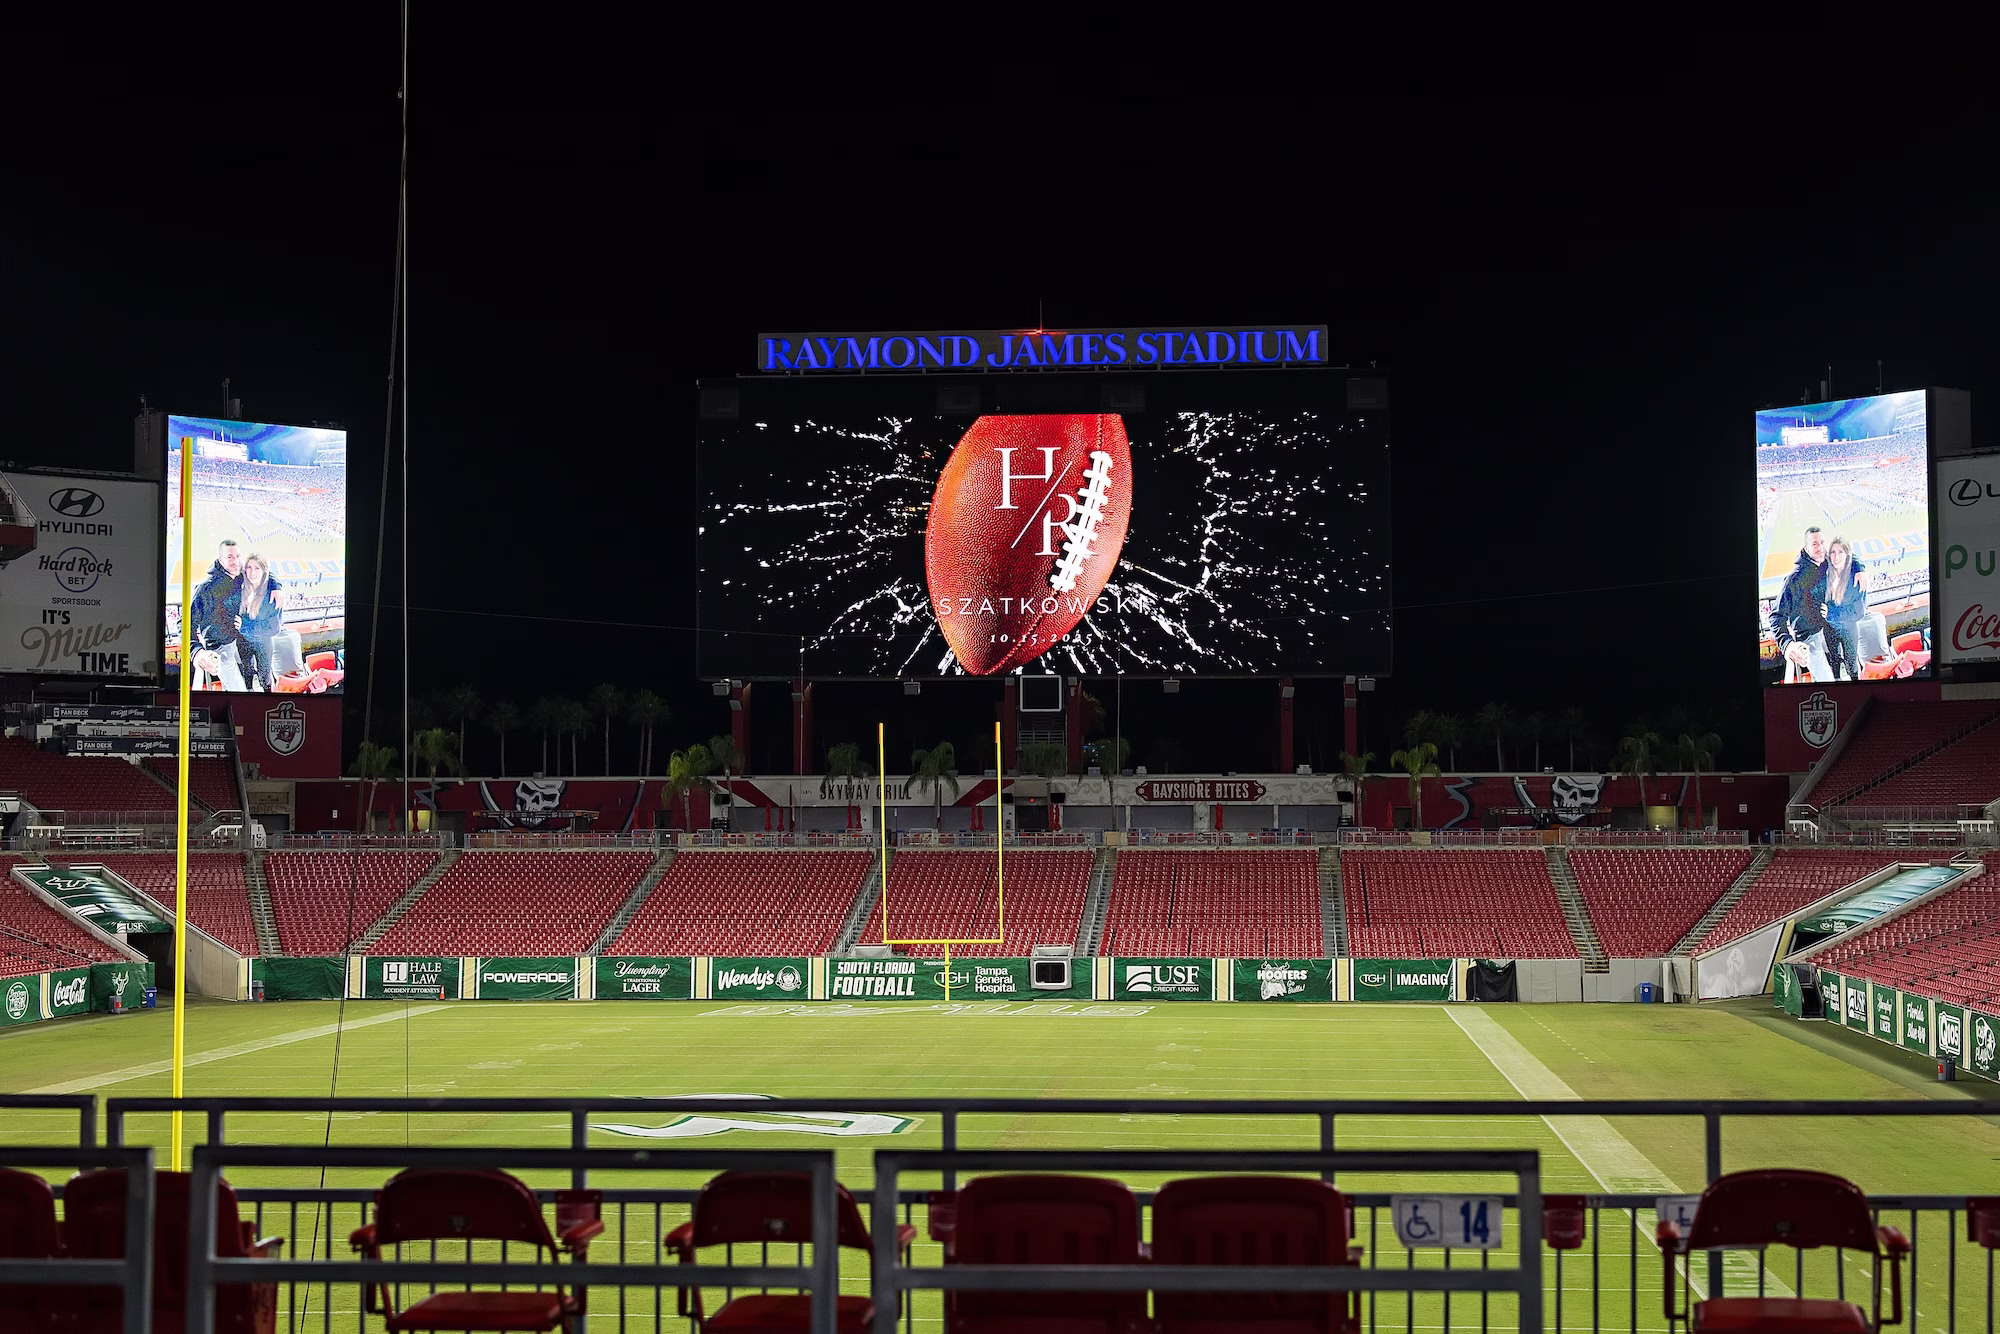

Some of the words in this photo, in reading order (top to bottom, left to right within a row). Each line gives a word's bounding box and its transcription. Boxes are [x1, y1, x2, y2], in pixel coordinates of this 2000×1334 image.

[763, 335, 980, 370] RAYMOND
[986, 333, 1126, 368] JAMES
[1136, 330, 1322, 366] STADIUM
[39, 520, 113, 536] HYUNDAI
[38, 555, 76, 573] Hard
[78, 556, 113, 577] Rock
[68, 577, 86, 585] BET
[52, 597, 101, 606] SPORTSBOOK
[939, 597, 1144, 615] SZATKOWSKI
[21, 623, 132, 668] Miller
[77, 652, 129, 673] TIME
[820, 784, 870, 800] SKYWAY
[1152, 783, 1211, 799] BAYSHORE
[1215, 783, 1249, 799] BITES
[409, 962, 442, 973] HALE
[614, 961, 671, 978] Yuengling
[837, 962, 871, 974] SOUTH
[872, 962, 915, 974] FLORIDA
[974, 966, 1008, 976] Tampa
[1153, 965, 1200, 984] USF
[1257, 969, 1308, 981] HOOTERS
[411, 973, 438, 984] LAW
[718, 966, 775, 991] Wendy's
[938, 972, 970, 983] TGH
[974, 975, 1013, 984] General
[1362, 974, 1386, 983] TGH
[1396, 974, 1449, 986] IMAGING
[622, 983, 661, 993] LAGER
[832, 977, 916, 996] FOOTBALL
[1460, 1200, 1490, 1243] 14
